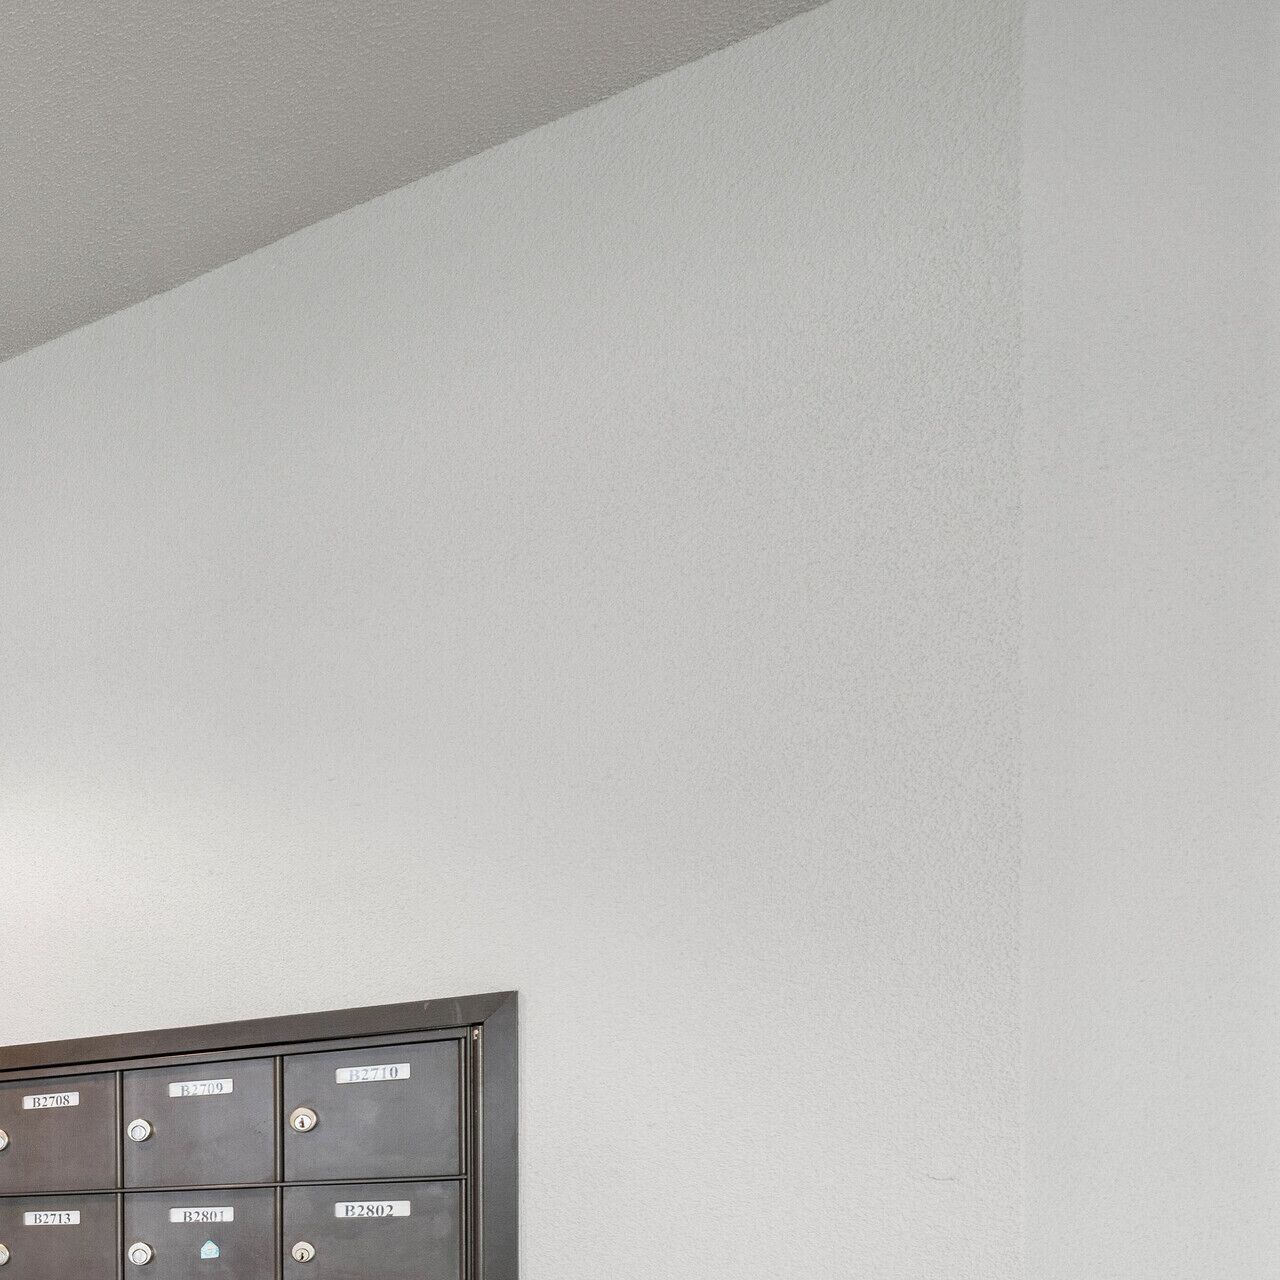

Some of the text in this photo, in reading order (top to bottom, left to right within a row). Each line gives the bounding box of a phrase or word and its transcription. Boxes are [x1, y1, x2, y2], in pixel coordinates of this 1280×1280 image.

[349, 1066, 399, 1081] B2710
[180, 1082, 223, 1096] B2709
[32, 1095, 70, 1108] B2708
[183, 1210, 225, 1223] B2801
[344, 1204, 393, 1217] B2802
[33, 1213, 71, 1224] B2713
